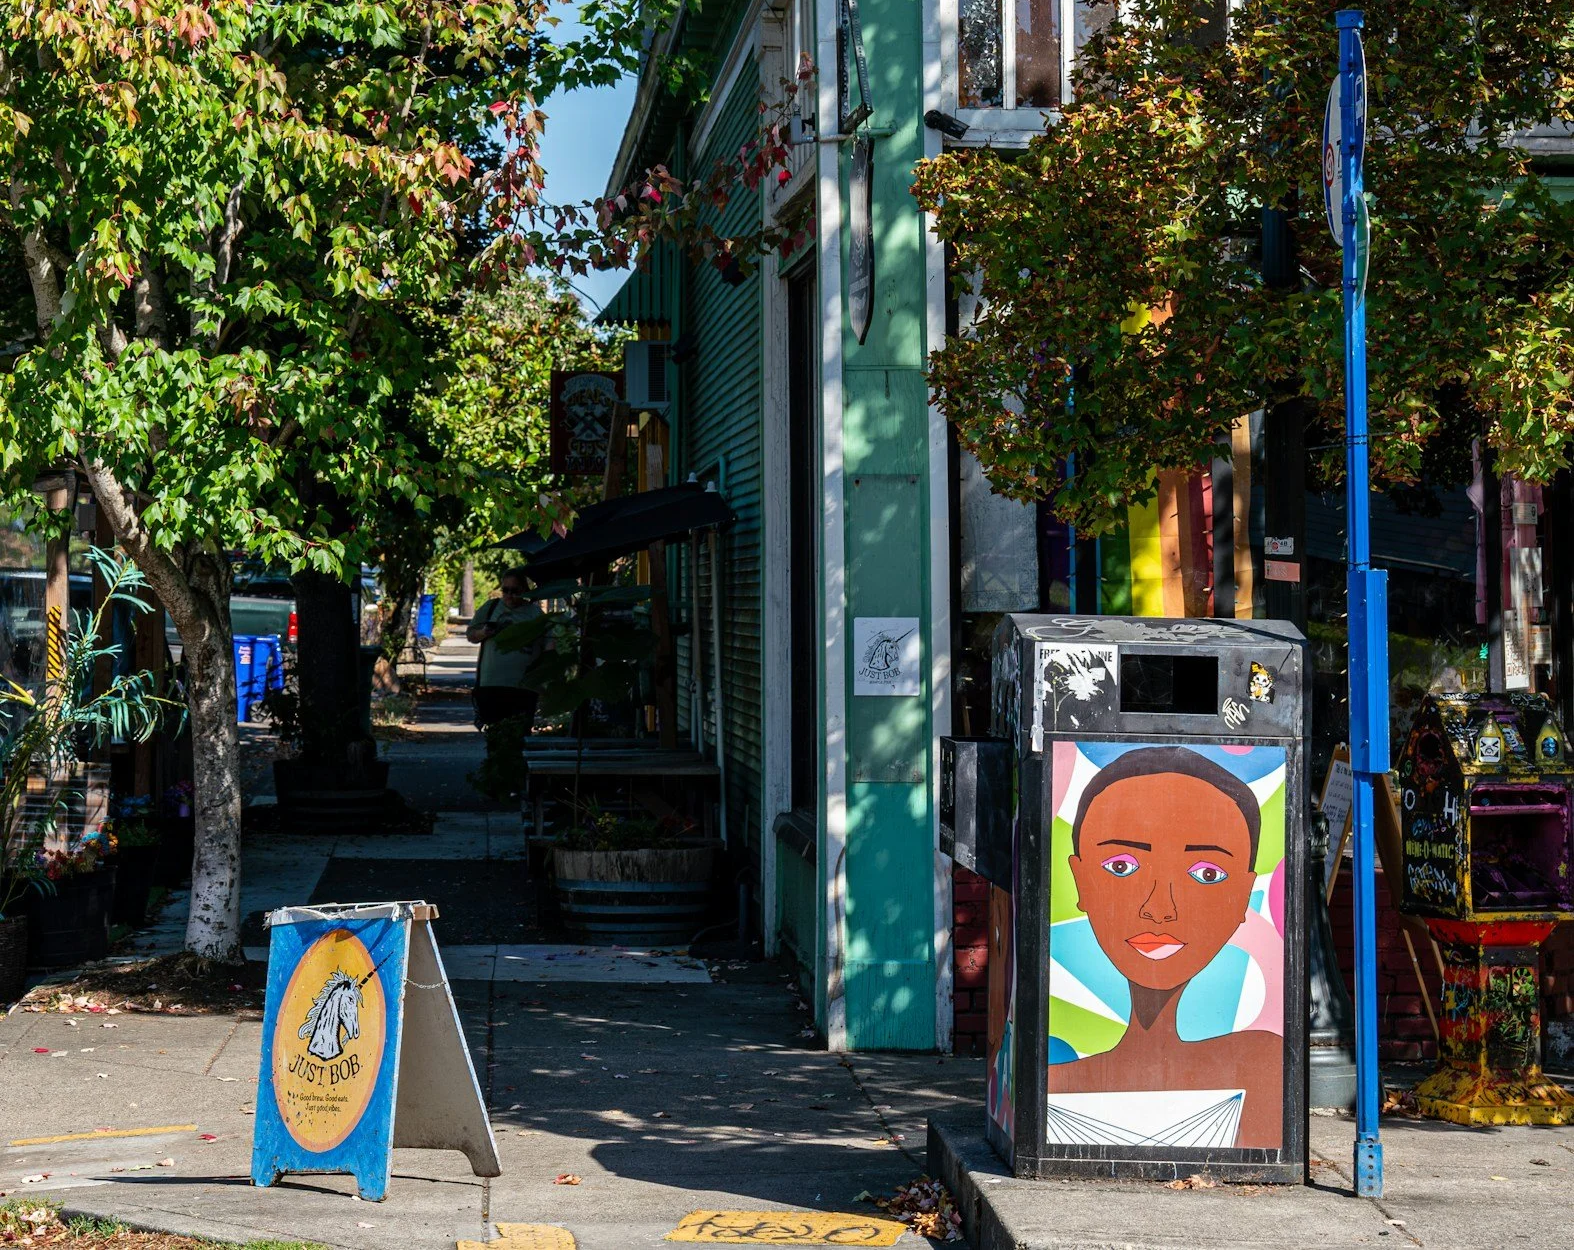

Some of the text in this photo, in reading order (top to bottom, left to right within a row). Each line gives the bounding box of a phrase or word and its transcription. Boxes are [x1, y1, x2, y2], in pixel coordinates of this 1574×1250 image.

[859, 667, 882, 680] JUST
[288, 1053, 325, 1086] JUST
[300, 1093, 311, 1101] Good
[325, 1093, 337, 1102] Good
[305, 1102, 316, 1111] Just
[317, 1104, 328, 1113] good
